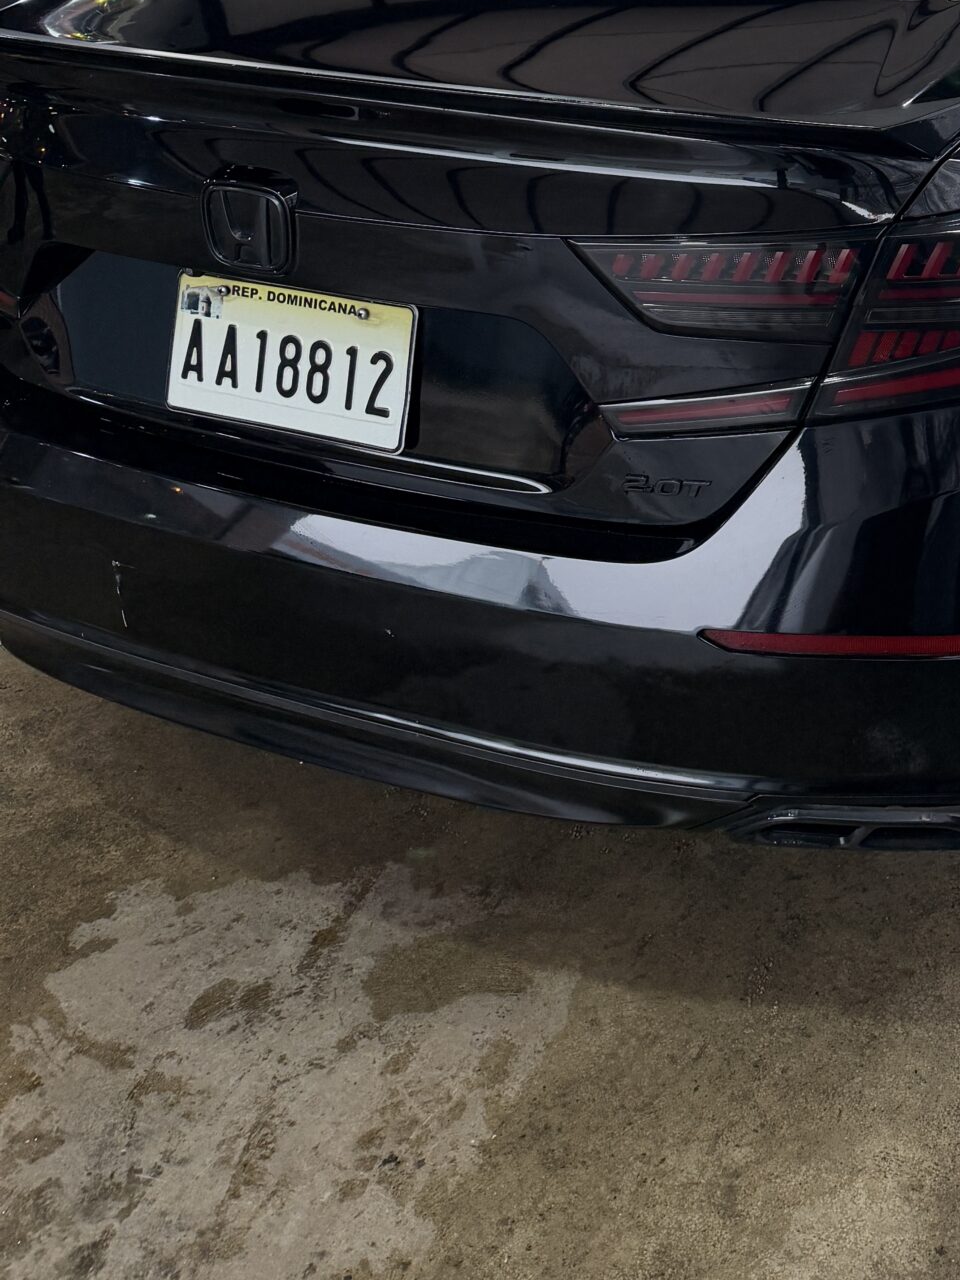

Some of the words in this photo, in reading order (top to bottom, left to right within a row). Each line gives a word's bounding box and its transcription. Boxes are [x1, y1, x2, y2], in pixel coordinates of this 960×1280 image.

[231, 285, 262, 300] REP.
[267, 290, 358, 316] DOMINICANA
[181, 318, 395, 419] AA18812
[623, 472, 712, 497] 2.0T
